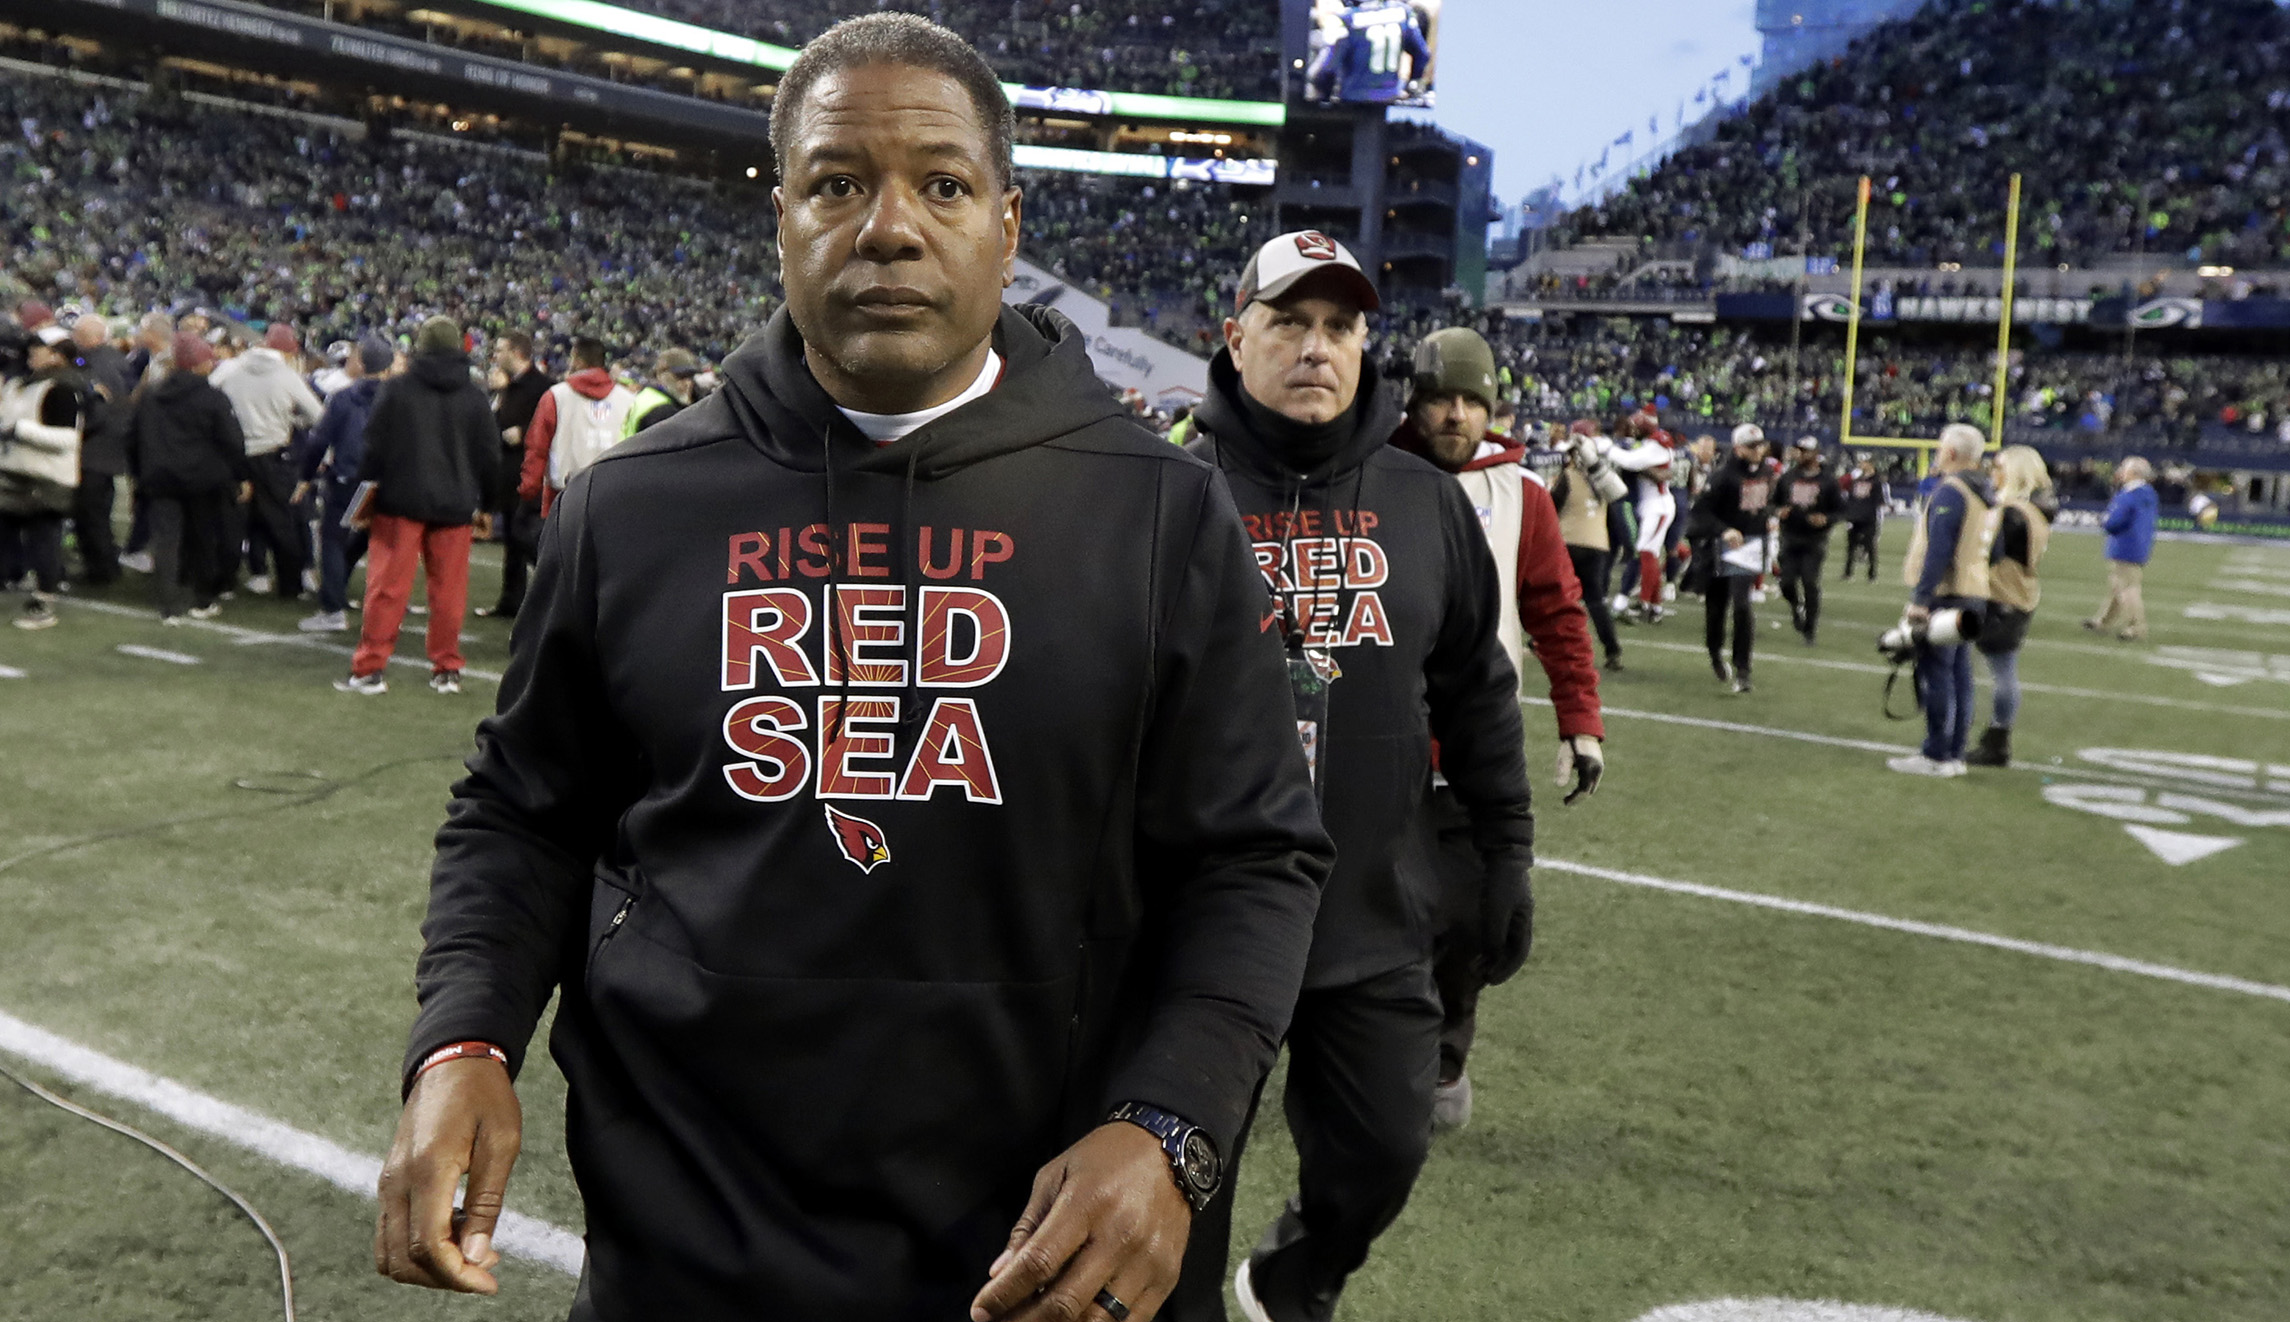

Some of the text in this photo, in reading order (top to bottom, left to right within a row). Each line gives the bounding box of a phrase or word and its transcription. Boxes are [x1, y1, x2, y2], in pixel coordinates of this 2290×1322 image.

[726, 522, 1015, 585] RISE UP
[1241, 509, 1380, 540] RISE UP
[1251, 537, 1389, 593] RED
[721, 584, 1012, 692] RED
[722, 695, 1004, 805] SEA
